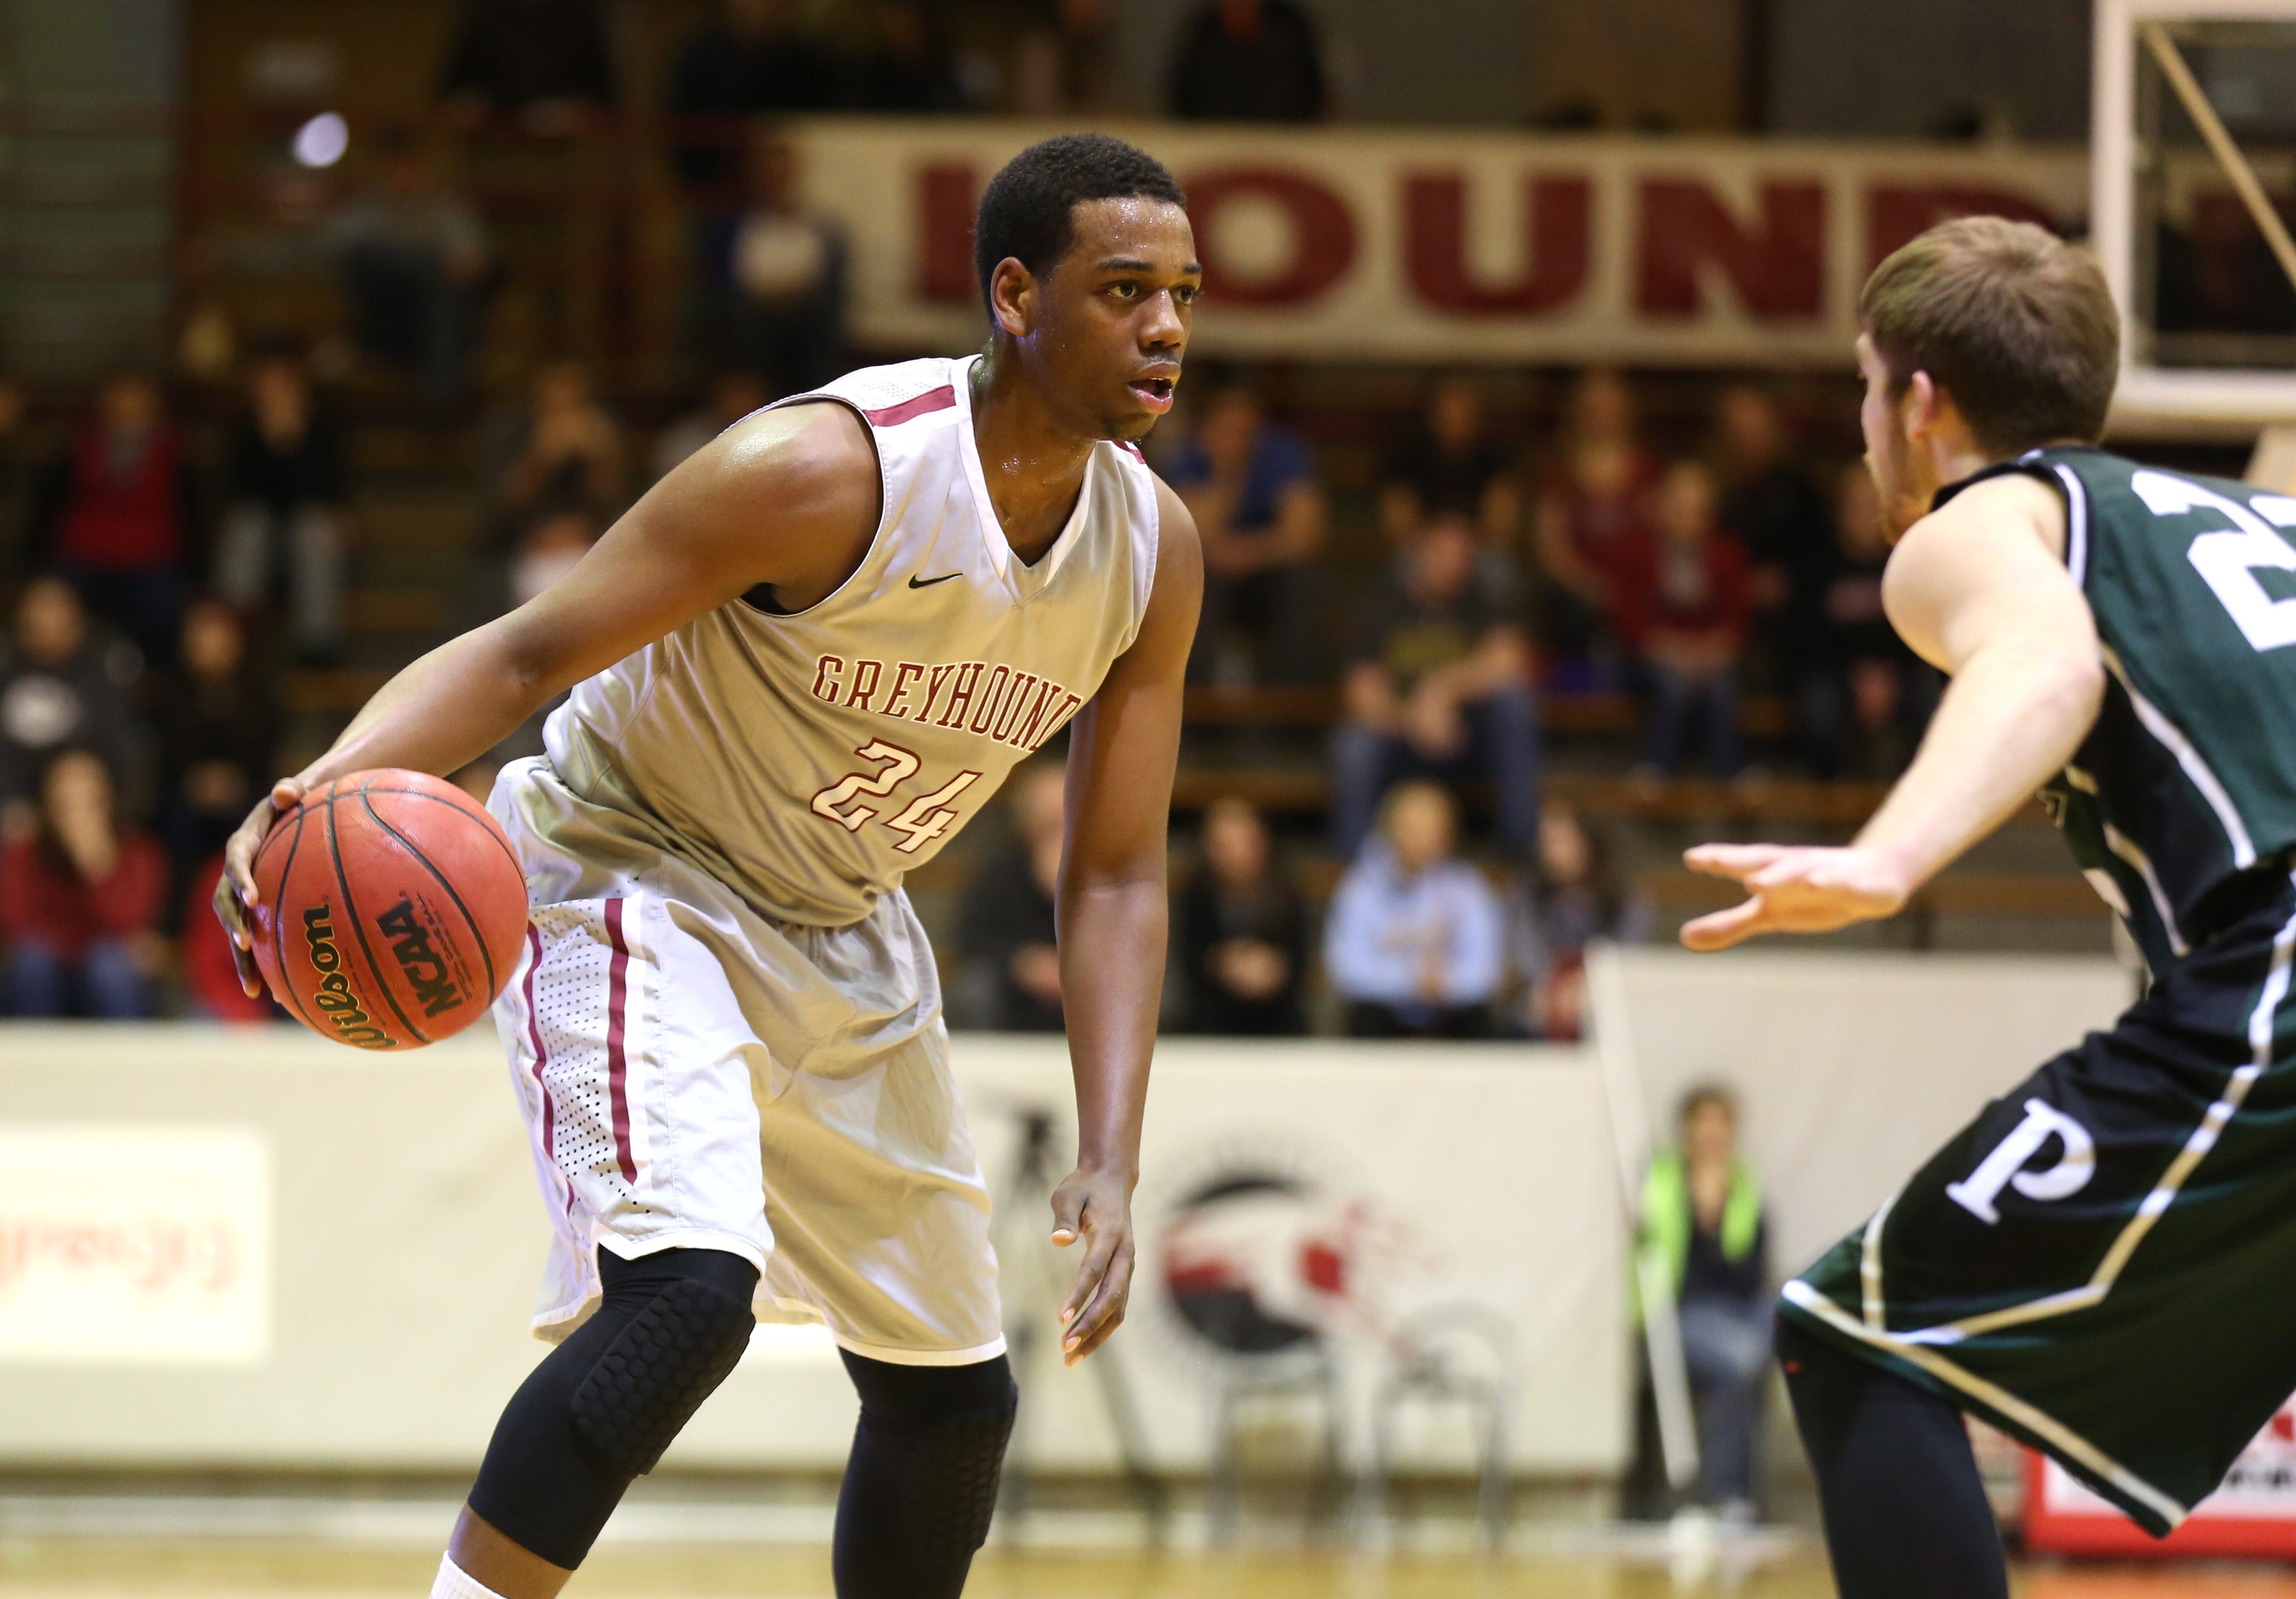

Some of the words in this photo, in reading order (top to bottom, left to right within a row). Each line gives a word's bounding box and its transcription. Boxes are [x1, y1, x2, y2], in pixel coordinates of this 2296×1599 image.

[915, 155, 2063, 317] OUN
[2131, 470, 2296, 653] 2
[809, 737, 984, 855] 24
[303, 903, 399, 1050] Wilson
[377, 901, 463, 1017] NCAA
[1944, 1097, 2097, 1225] P
